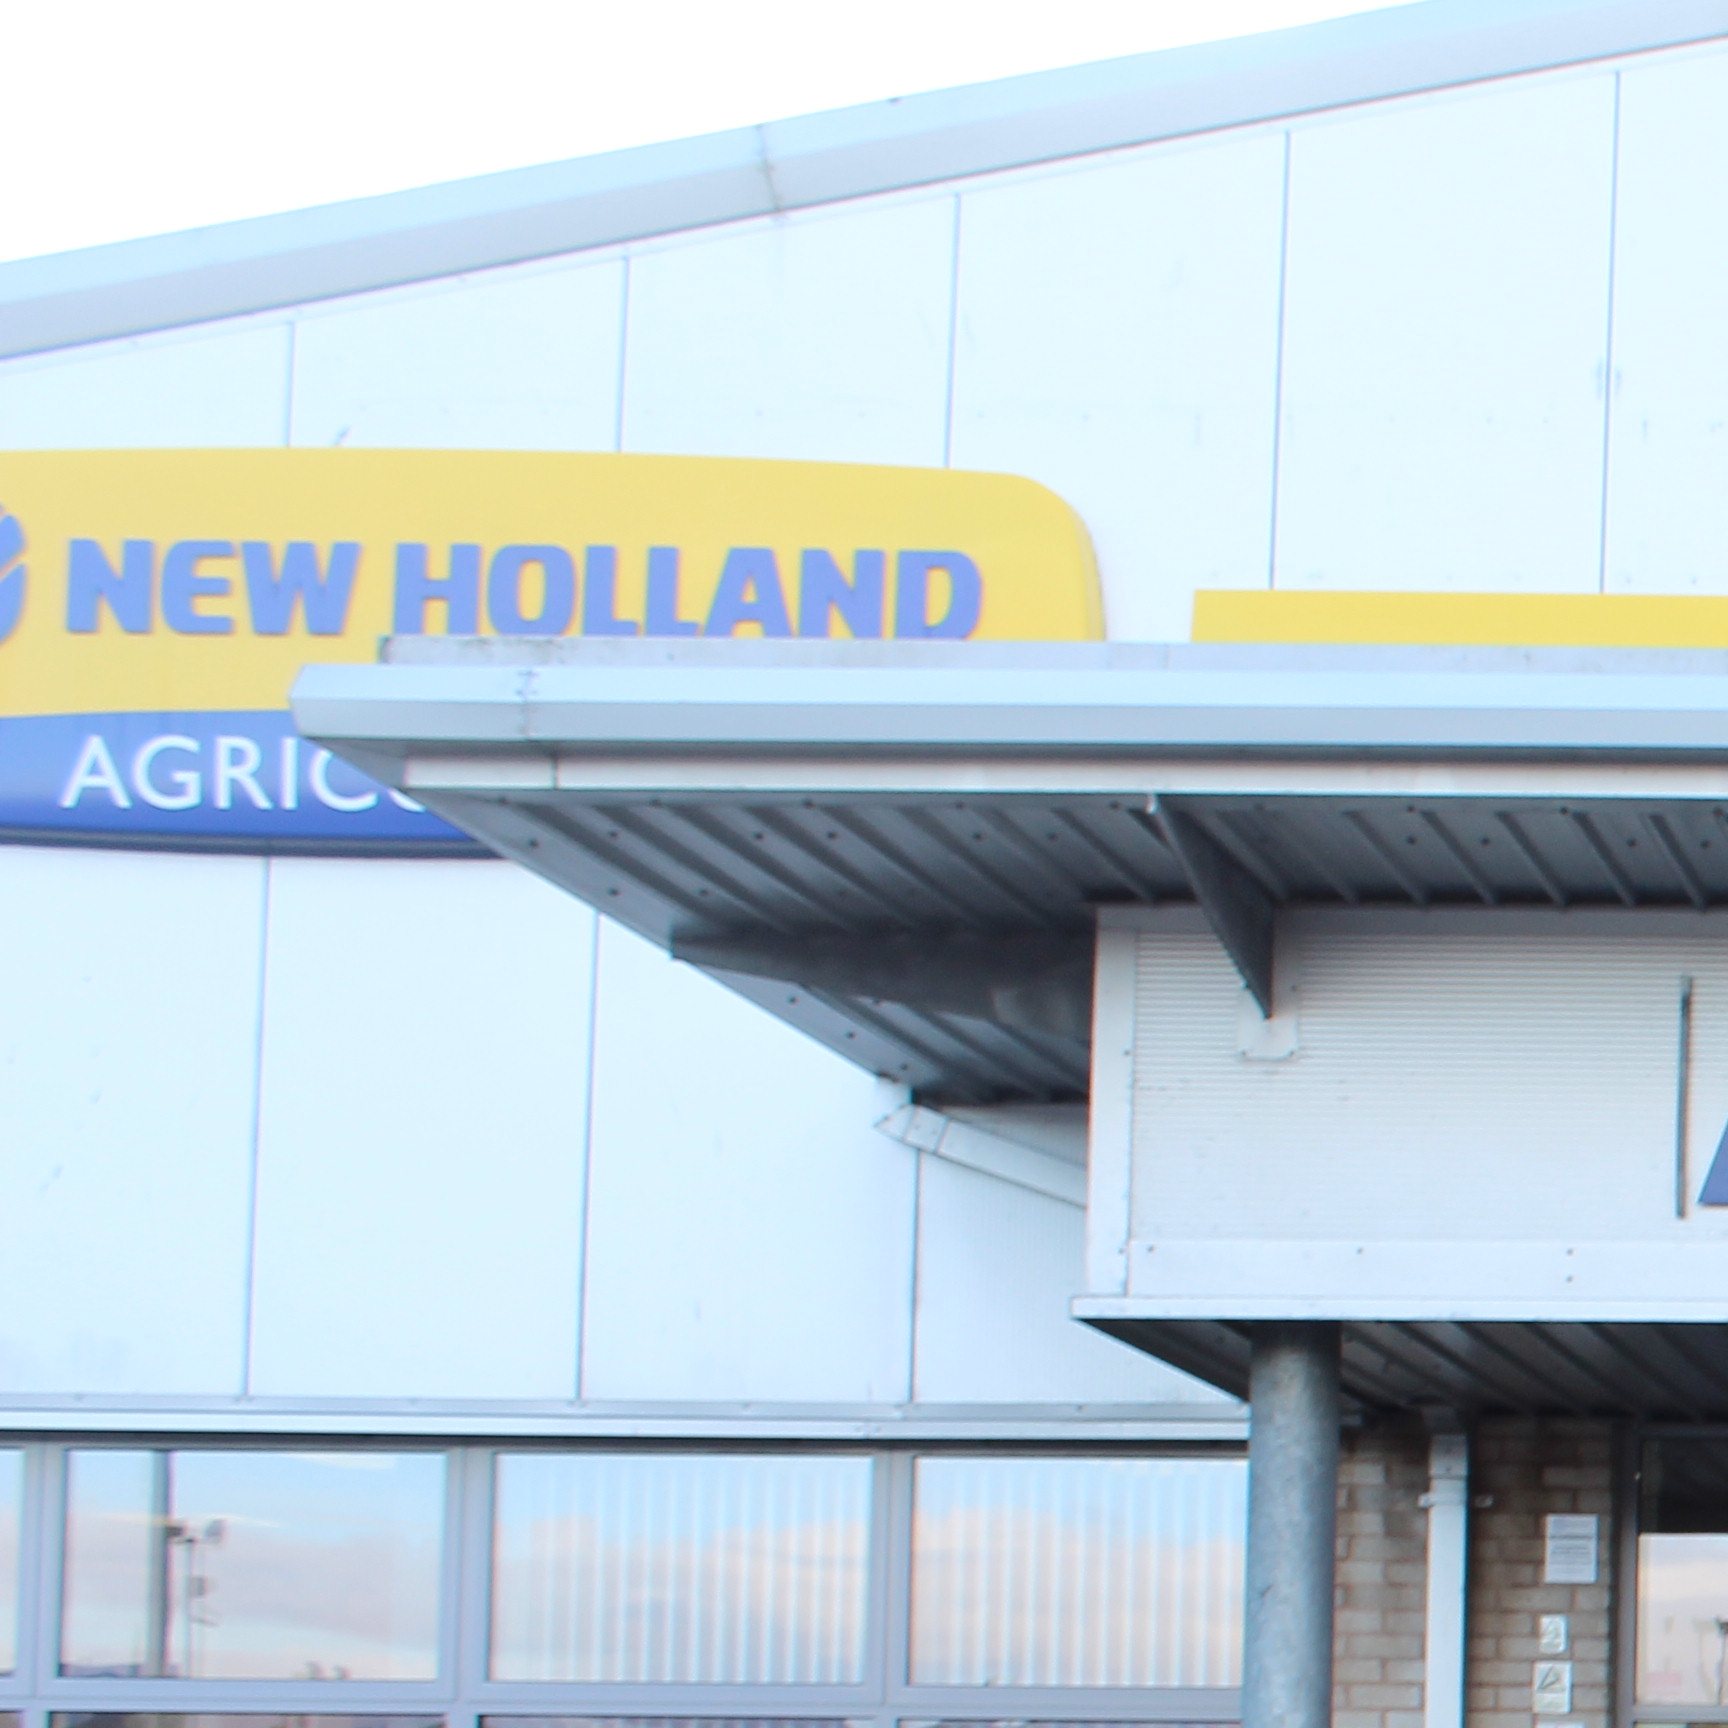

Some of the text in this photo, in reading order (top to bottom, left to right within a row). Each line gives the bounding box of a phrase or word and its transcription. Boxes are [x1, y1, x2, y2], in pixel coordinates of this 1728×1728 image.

[65, 538, 984, 640] NEW HOLLAND
[61, 735, 427, 814] AGRIC
